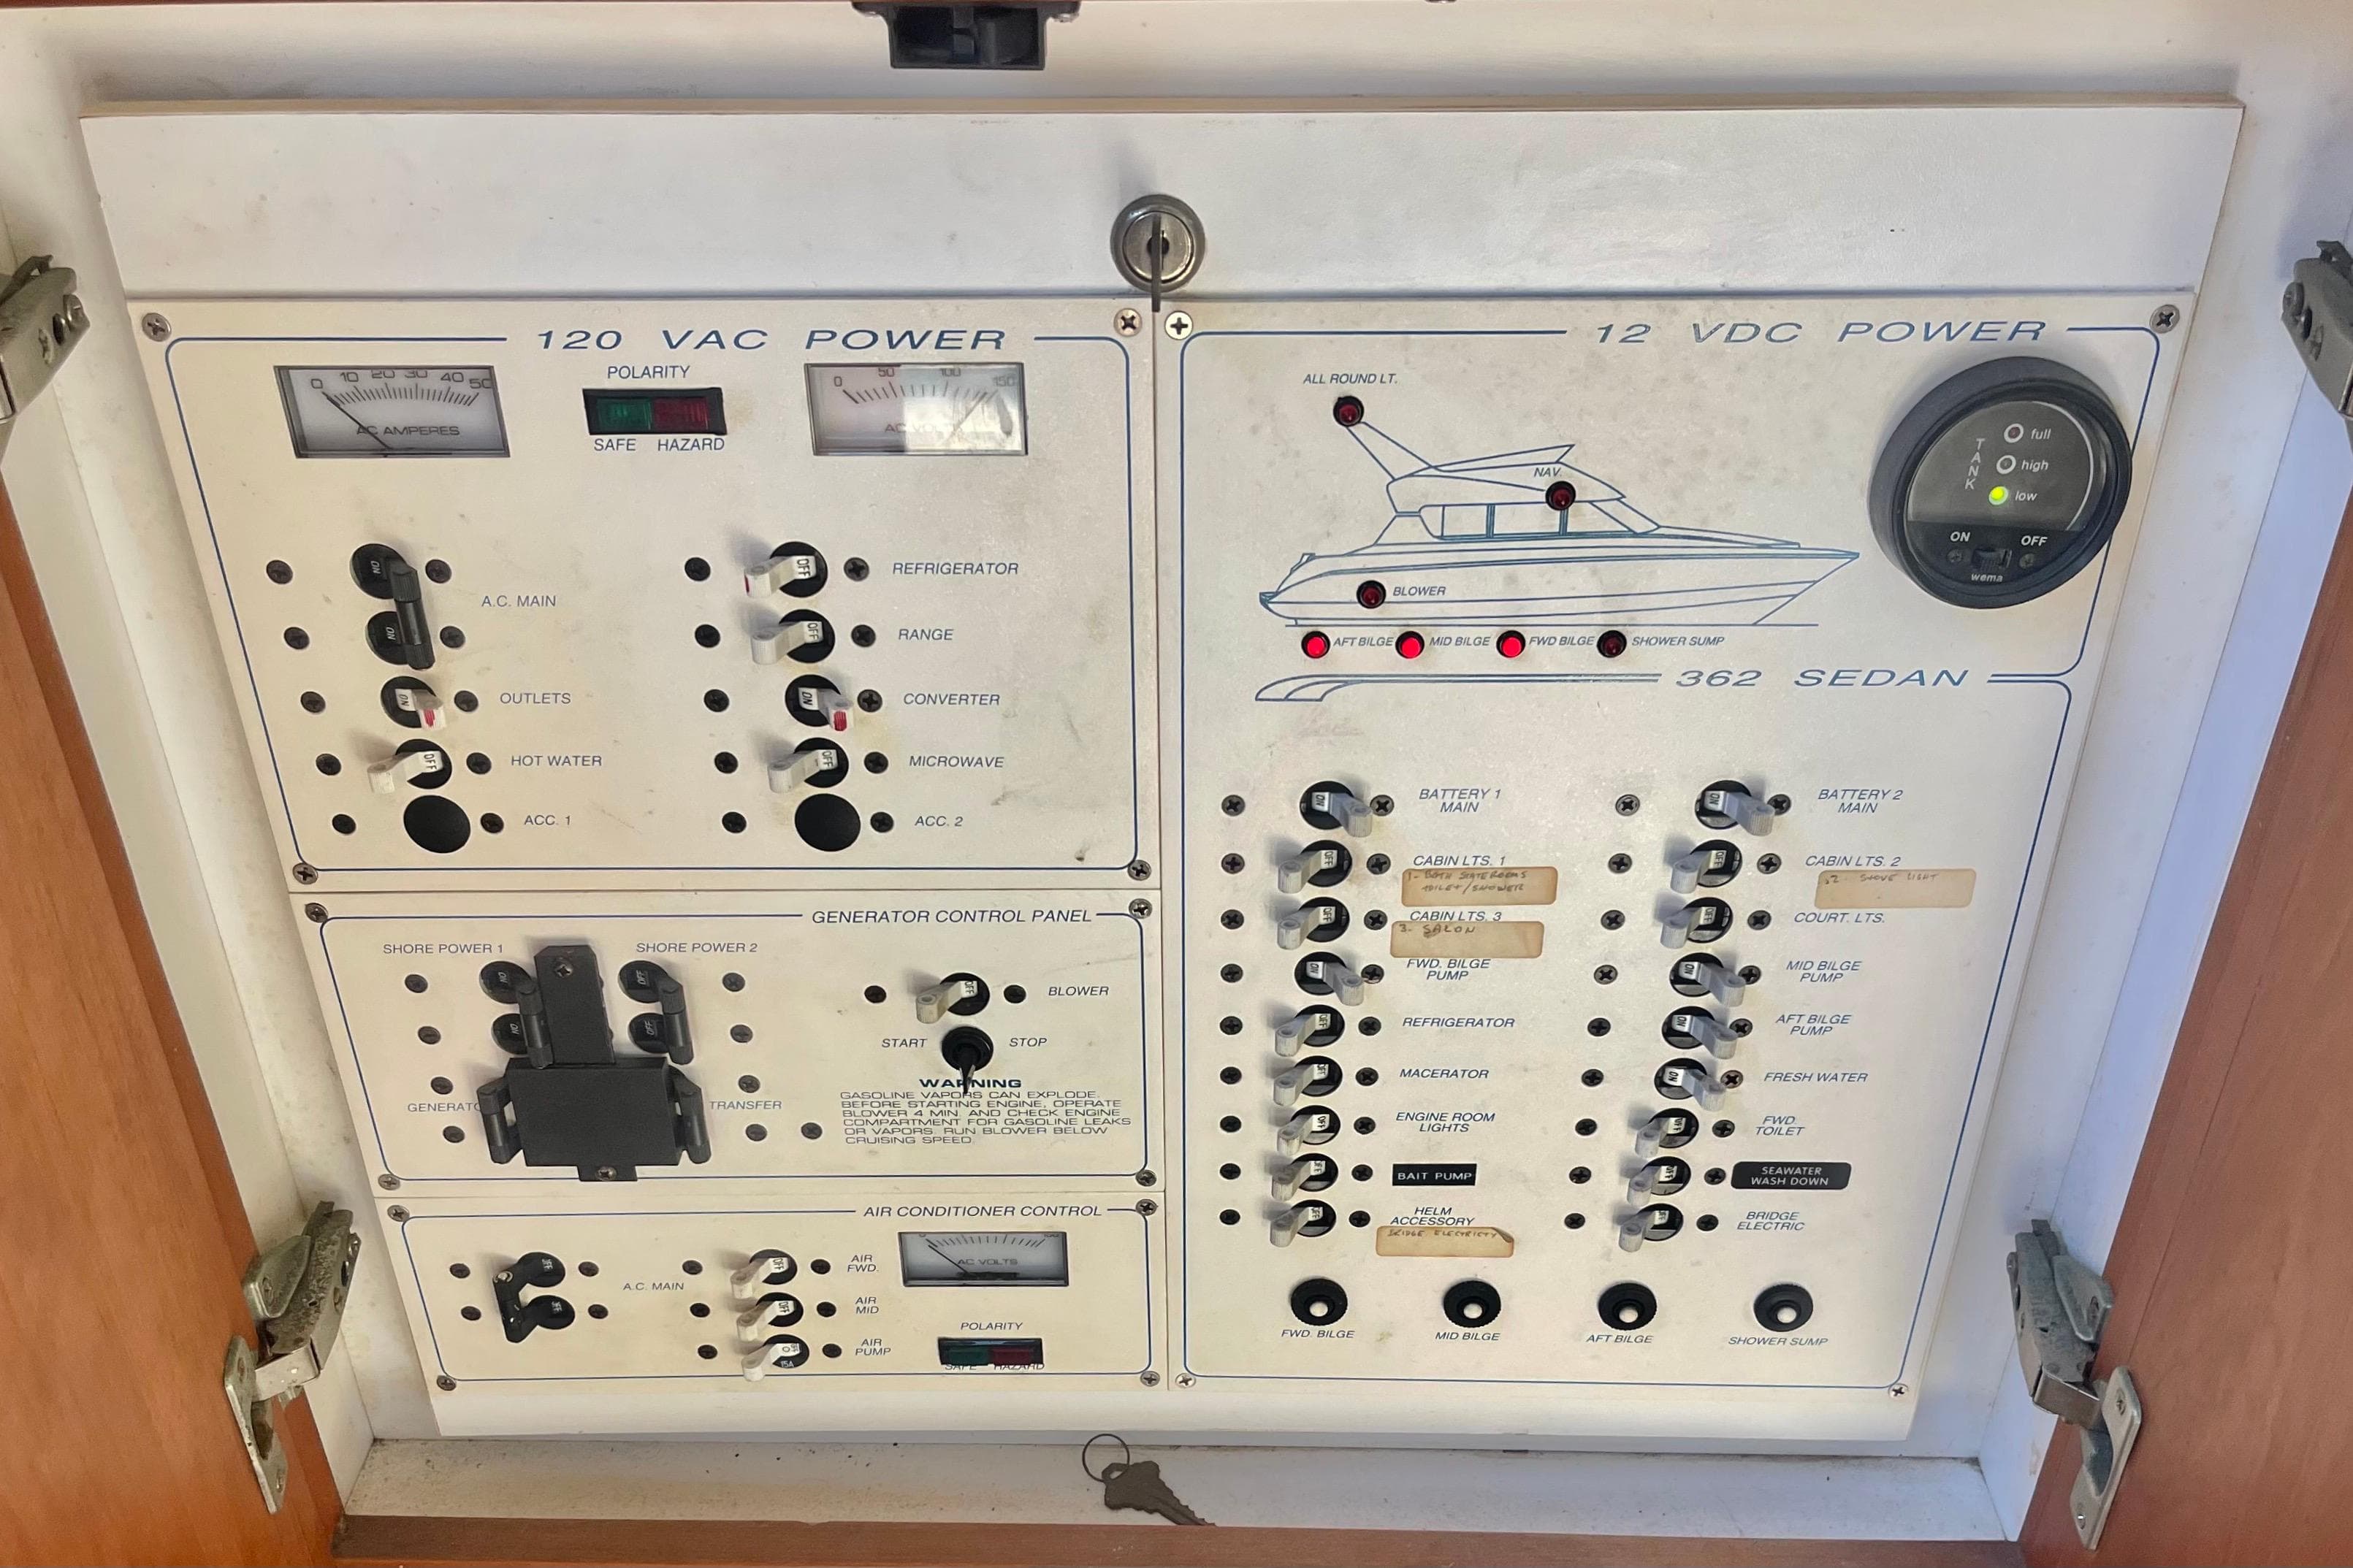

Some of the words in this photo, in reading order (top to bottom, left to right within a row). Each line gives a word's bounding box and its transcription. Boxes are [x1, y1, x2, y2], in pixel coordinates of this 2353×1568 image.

[1598, 324, 1651, 343] 12
[1693, 323, 1802, 343] VDC
[1838, 321, 2045, 342] POWER
[538, 331, 622, 349] 120
[663, 330, 767, 349] VAC
[806, 330, 1004, 349] POWER
[340, 372, 358, 382] 10
[441, 372, 463, 382] 40
[608, 366, 690, 379] POLARITY
[1303, 374, 1325, 383] ALL
[1330, 374, 1376, 383] ROUND
[1379, 373, 1397, 384] LT.
[384, 427, 460, 435] AMPERES
[2031, 429, 2051, 439] full
[594, 438, 636, 451] SAFE
[658, 438, 724, 451] HAZARD
[2021, 460, 2048, 472] high
[2016, 491, 2037, 500] low
[1950, 532, 1970, 541] ON
[2021, 535, 2048, 546] OFF
[893, 562, 1018, 575] REFRIGERATOR
[1972, 573, 2002, 581] wema
[1393, 586, 1446, 596] BLOWER
[481, 595, 511, 607] A.C.
[517, 595, 555, 606] MAIN
[899, 629, 953, 640] RANGE
[1333, 638, 1357, 646] AFT
[1358, 637, 1394, 646] BILGE
[1429, 637, 1451, 646] MID
[1455, 637, 1491, 646] BILGE
[1529, 637, 1556, 646] FWD
[1559, 636, 1595, 646] BILGE
[1632, 637, 1687, 646] SHOWER
[1689, 637, 1724, 646] SUMP
[1677, 670, 1761, 687] 362
[1794, 670, 1968, 687] SEDAN
[500, 693, 571, 704] OUTLETS
[904, 693, 1000, 705] CONVERTER
[511, 755, 543, 766] HOT
[548, 756, 601, 766] WATER
[909, 756, 1004, 768] MICROWAVE
[1419, 789, 1491, 799] BATTERY
[1495, 789, 1500, 799] 1
[1818, 789, 1891, 800] BATTERY
[1893, 790, 1903, 800] 2
[1441, 802, 1479, 812] MAIN
[1838, 803, 1877, 813] MAIN
[525, 815, 560, 825] ACC.
[565, 816, 570, 825] 1
[915, 816, 950, 827] ACC.
[955, 816, 963, 827] 2
[1414, 856, 1459, 865] CABIN
[1462, 856, 1493, 866] LTS.
[1500, 856, 1505, 866] 1
[1805, 856, 1853, 867] CABIN
[1855, 856, 1885, 867] LTS.
[1891, 856, 1901, 867] 2
[812, 911, 929, 923] GENERATOR
[936, 910, 1025, 922] CONTROL
[1032, 910, 1091, 922] PANEL
[1410, 911, 1457, 922] CABIN
[1459, 911, 1487, 922] LTS.
[1493, 911, 1501, 921] 3
[1794, 913, 1849, 923] COURT.
[1855, 913, 1885, 923] LTS.
[384, 944, 433, 954] SHORE
[439, 944, 492, 953] POWER
[498, 944, 502, 953] 1
[636, 943, 687, 952] SHORE
[693, 943, 745, 952] POWER
[750, 944, 758, 952] 2
[1407, 960, 1442, 968] FWD.
[1447, 960, 1490, 968] BILGE
[1786, 961, 1814, 970] MID
[1818, 961, 1861, 971] BILGE
[1427, 971, 1468, 980] PUMP
[1800, 973, 1843, 982] PUMP
[1049, 987, 1109, 995] BLOWER
[1403, 1017, 1515, 1027] REFRIGERATOR
[1776, 1014, 1805, 1023] AFT
[1807, 1014, 1852, 1024] BILGE
[1791, 1026, 1832, 1035] PUMP
[882, 1039, 927, 1047] START
[1010, 1038, 1047, 1047] STOP
[1400, 1069, 1489, 1078] MACERATOR
[1764, 1073, 1813, 1082] FRESH
[1818, 1073, 1868, 1082] WATER
[709, 1101, 782, 1109] TRANSFER
[1396, 1112, 1448, 1121] ENGINE
[1452, 1113, 1495, 1122] ROOM
[944, 1127, 975, 1135] RUN
[1419, 1123, 1469, 1132] LIGHTS
[1757, 1127, 1805, 1136] TOILET
[1762, 1167, 1822, 1175] SEAWATER
[1791, 1177, 1828, 1185] DOWN
[863, 1207, 891, 1217] AIR
[897, 1206, 1015, 1217] CONDITIONER
[1021, 1206, 1101, 1216] CONTROL
[1415, 1207, 1452, 1215] HELM
[1746, 1212, 1799, 1220] BRIDGE
[1391, 1217, 1475, 1225] ACCESSORY
[1737, 1221, 1805, 1231] ELECTRIC
[847, 1264, 879, 1272] FWD.
[1281, 1329, 1313, 1338] FWD.
[1317, 1330, 1354, 1338] BILGE
[1614, 1335, 1652, 1343] BILGE
[1728, 1337, 1787, 1345] SHOWER
